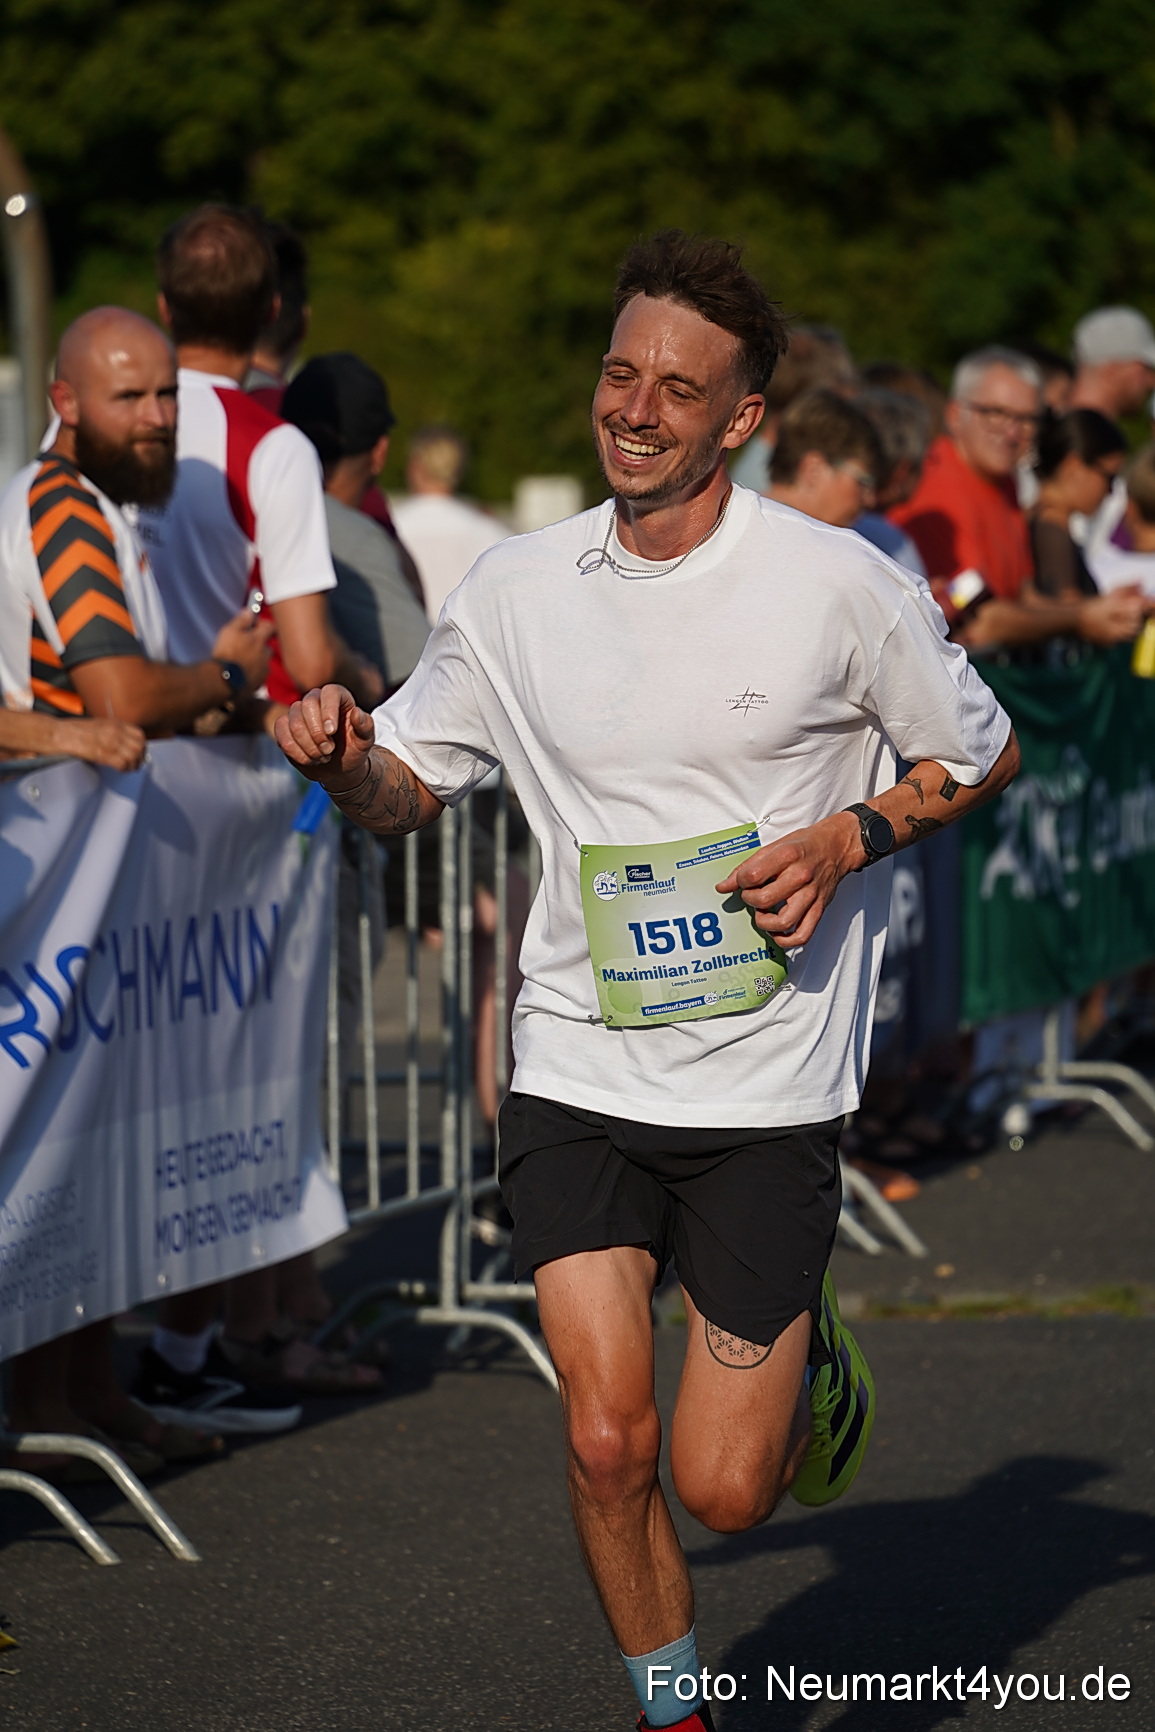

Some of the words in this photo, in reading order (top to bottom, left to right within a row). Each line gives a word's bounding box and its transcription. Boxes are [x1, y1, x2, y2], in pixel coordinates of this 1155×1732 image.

[621, 877, 675, 893] Firmenlauf
[643, 886, 676, 897] neumarkt
[627, 911, 723, 957] 1518
[602, 963, 689, 983] Maximilian
[691, 946, 776, 974] Zollbrecht
[690, 976, 707, 985] Tattoo
[644, 999, 702, 1016] firmenlauf.bayern
